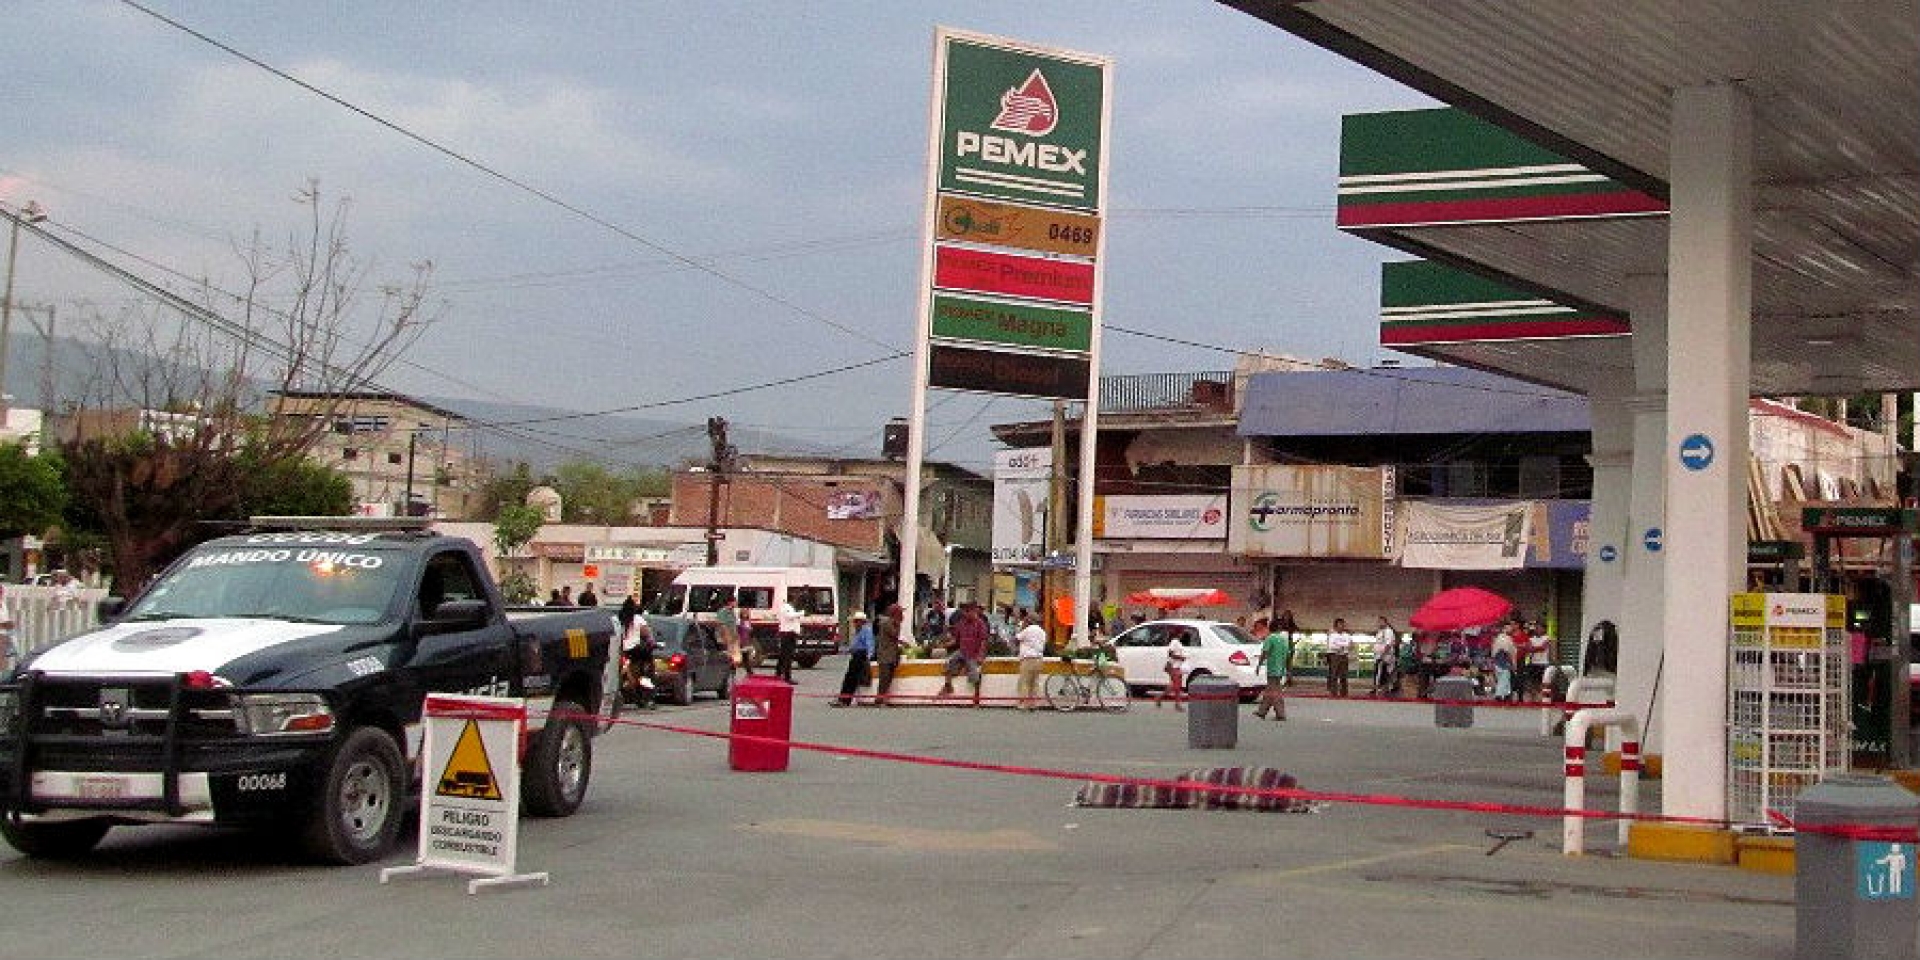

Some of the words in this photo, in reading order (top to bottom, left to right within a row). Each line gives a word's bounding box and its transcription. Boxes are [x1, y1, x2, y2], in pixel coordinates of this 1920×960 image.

[957, 130, 1087, 175] PEMEX
[1049, 223, 1093, 244] 0469
[1000, 264, 1090, 288] Premium
[998, 313, 1067, 338] Magna
[1837, 515, 1887, 525] PEMEX
[186, 550, 291, 568] MANDO
[1785, 607, 1821, 615] PEMEX
[238, 772, 287, 790] 00068
[443, 810, 490, 827] PELIGRO
[430, 826, 502, 842] DESCARGANDO
[432, 840, 498, 856] COMBUSTIBLE
